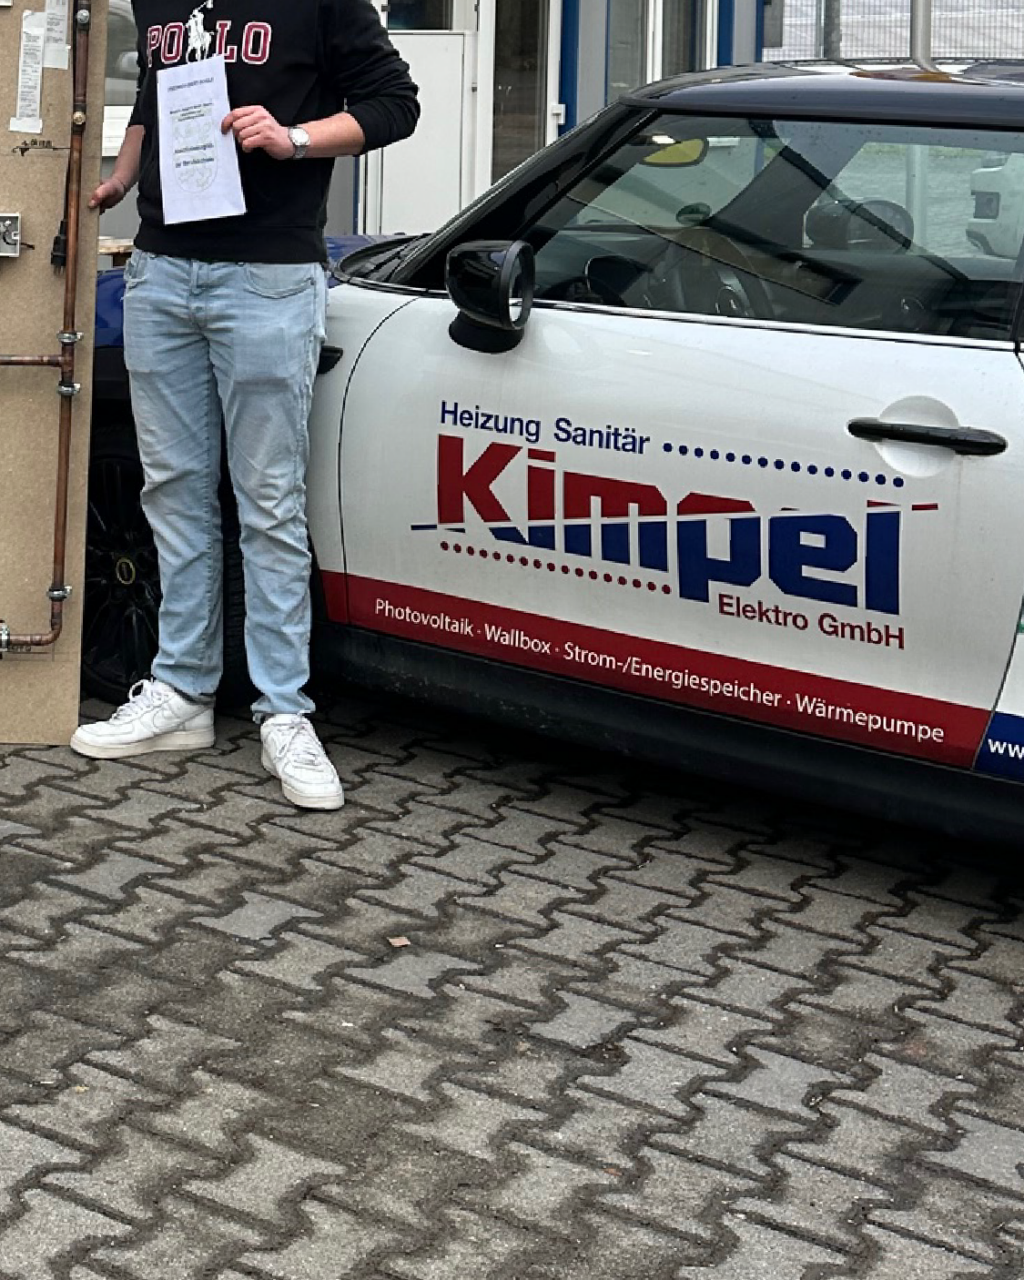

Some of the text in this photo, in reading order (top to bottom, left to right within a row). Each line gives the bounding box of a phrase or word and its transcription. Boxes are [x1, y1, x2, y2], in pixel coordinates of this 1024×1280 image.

[440, 400, 651, 454] Heizung Sanitär
[437, 433, 901, 616] Kimpel
[375, 598, 945, 743] Photovoltaik Wallbox Strom-/Energiespeicher Wärmepumpe
[718, 593, 905, 650] Elektro GmbH
